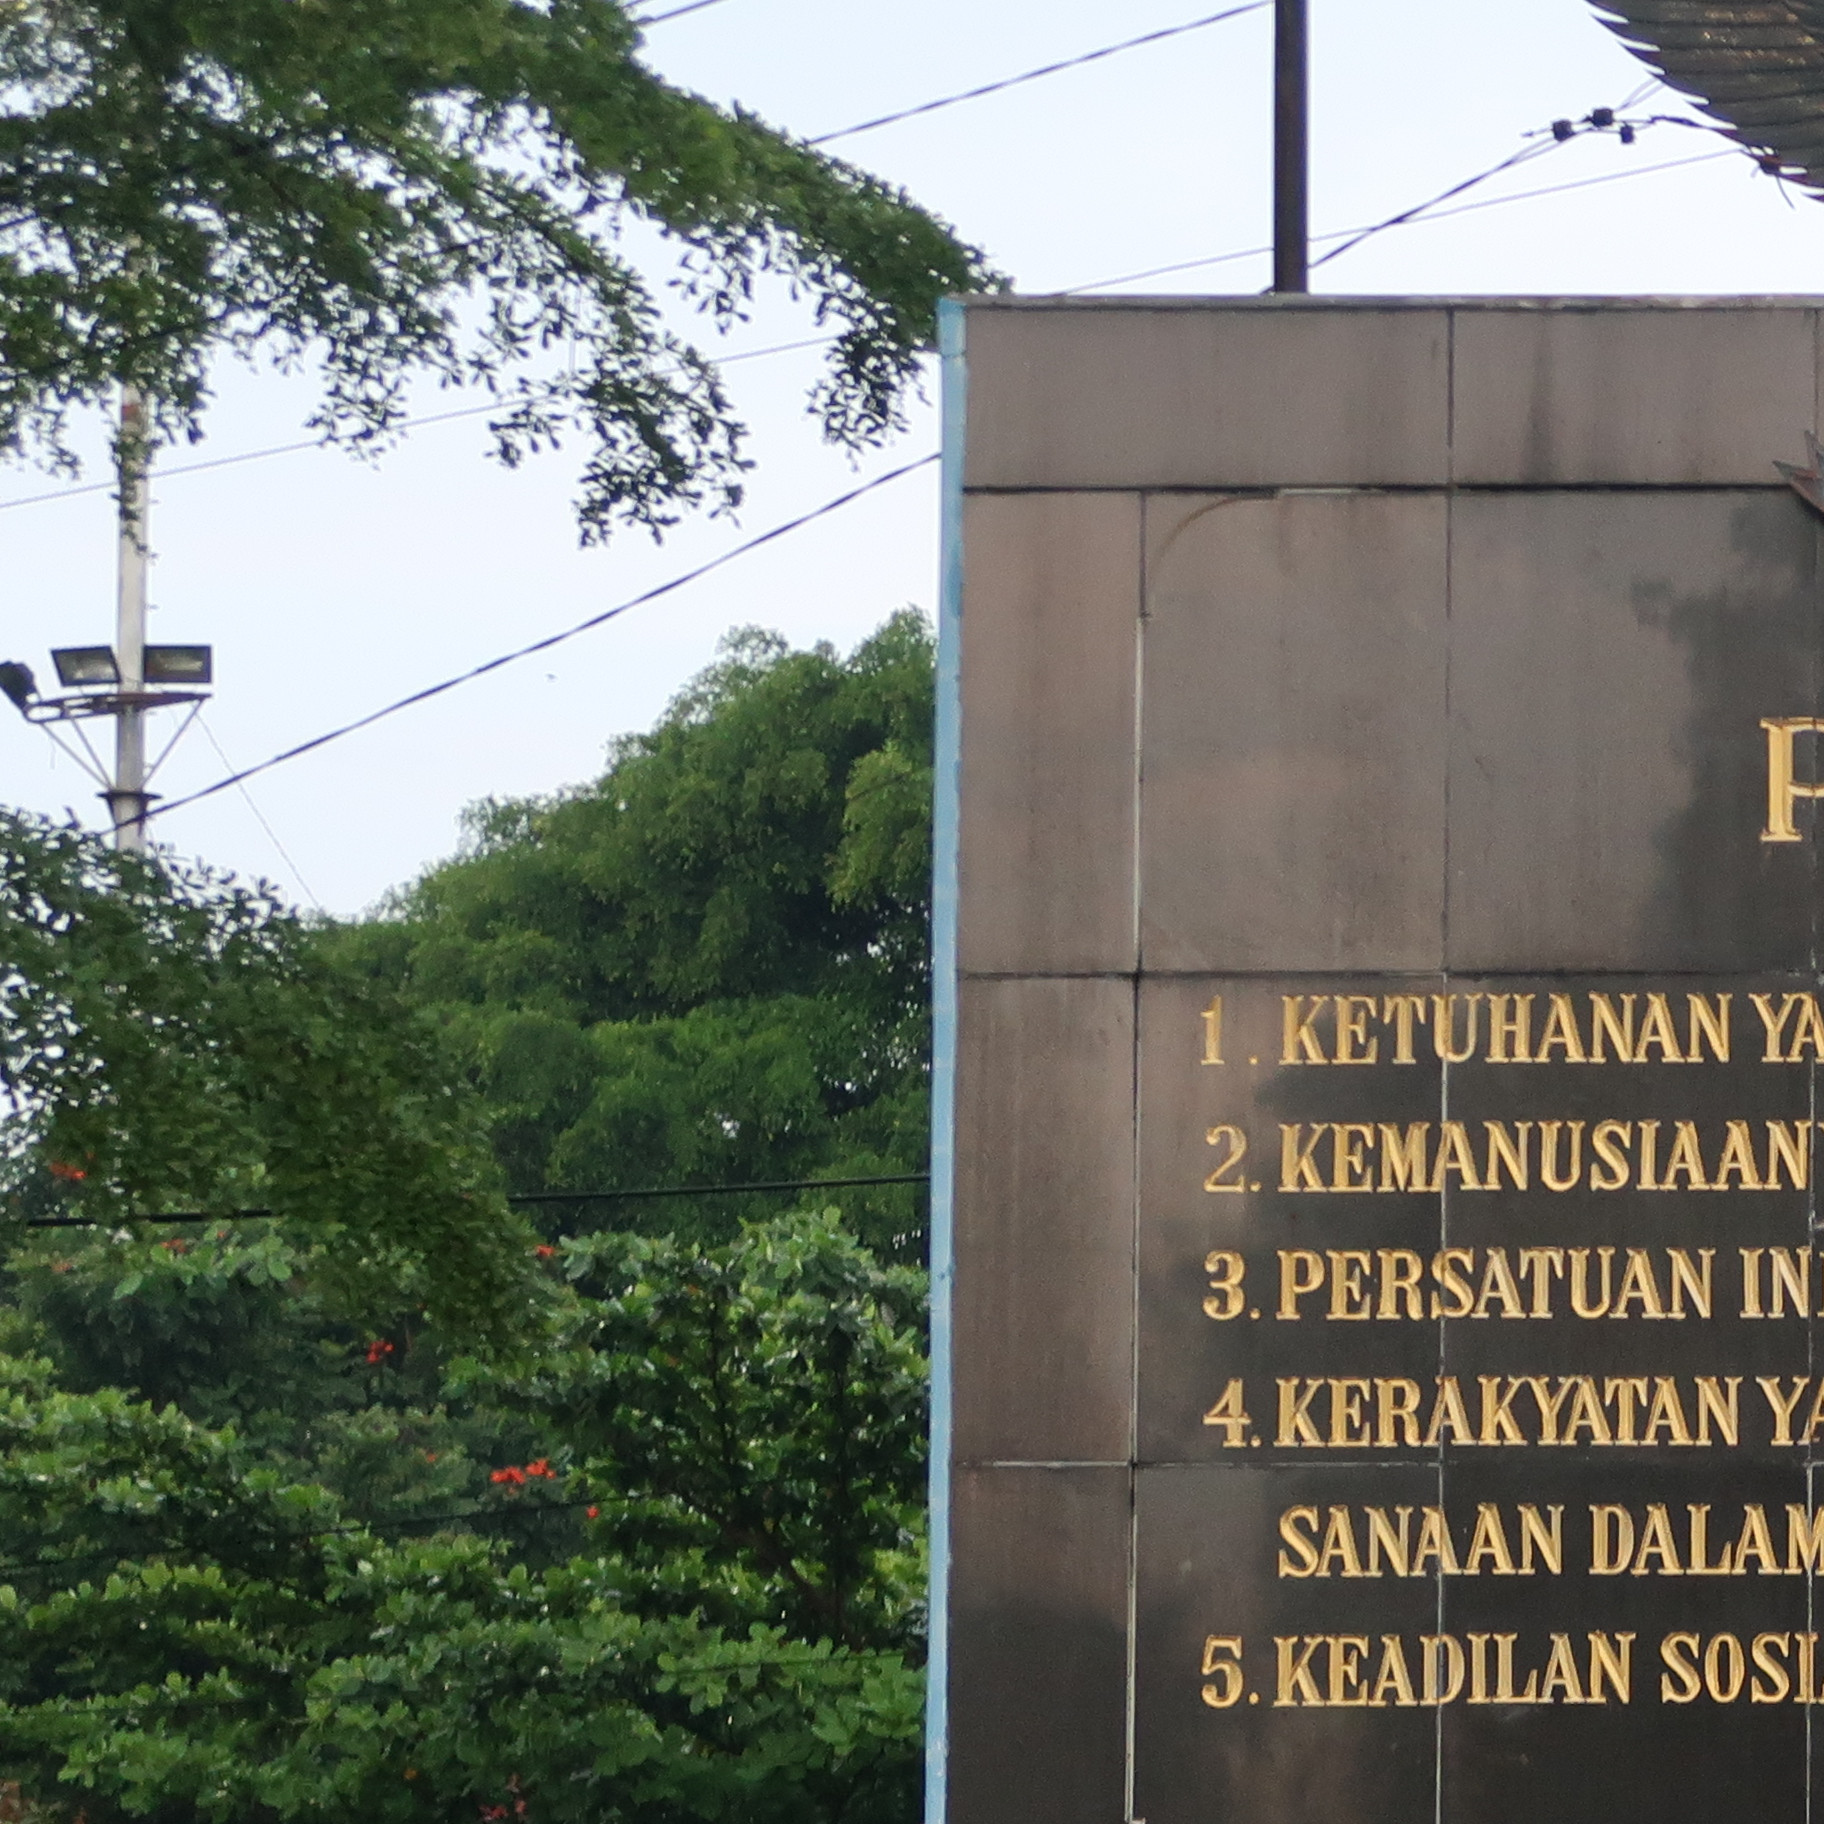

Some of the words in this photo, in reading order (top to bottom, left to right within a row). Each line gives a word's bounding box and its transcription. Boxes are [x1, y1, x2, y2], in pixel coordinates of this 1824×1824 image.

[1278, 990, 1732, 1067] KETUHANAN
[1276, 1118, 1812, 1194] KEMANUSIAAN
[1274, 1245, 1717, 1322] PERSATUAN
[1273, 1374, 1743, 1449] KERAKYATAN
[1277, 1502, 1564, 1579] SANAAN
[1272, 1630, 1638, 1709] KEADILAN
